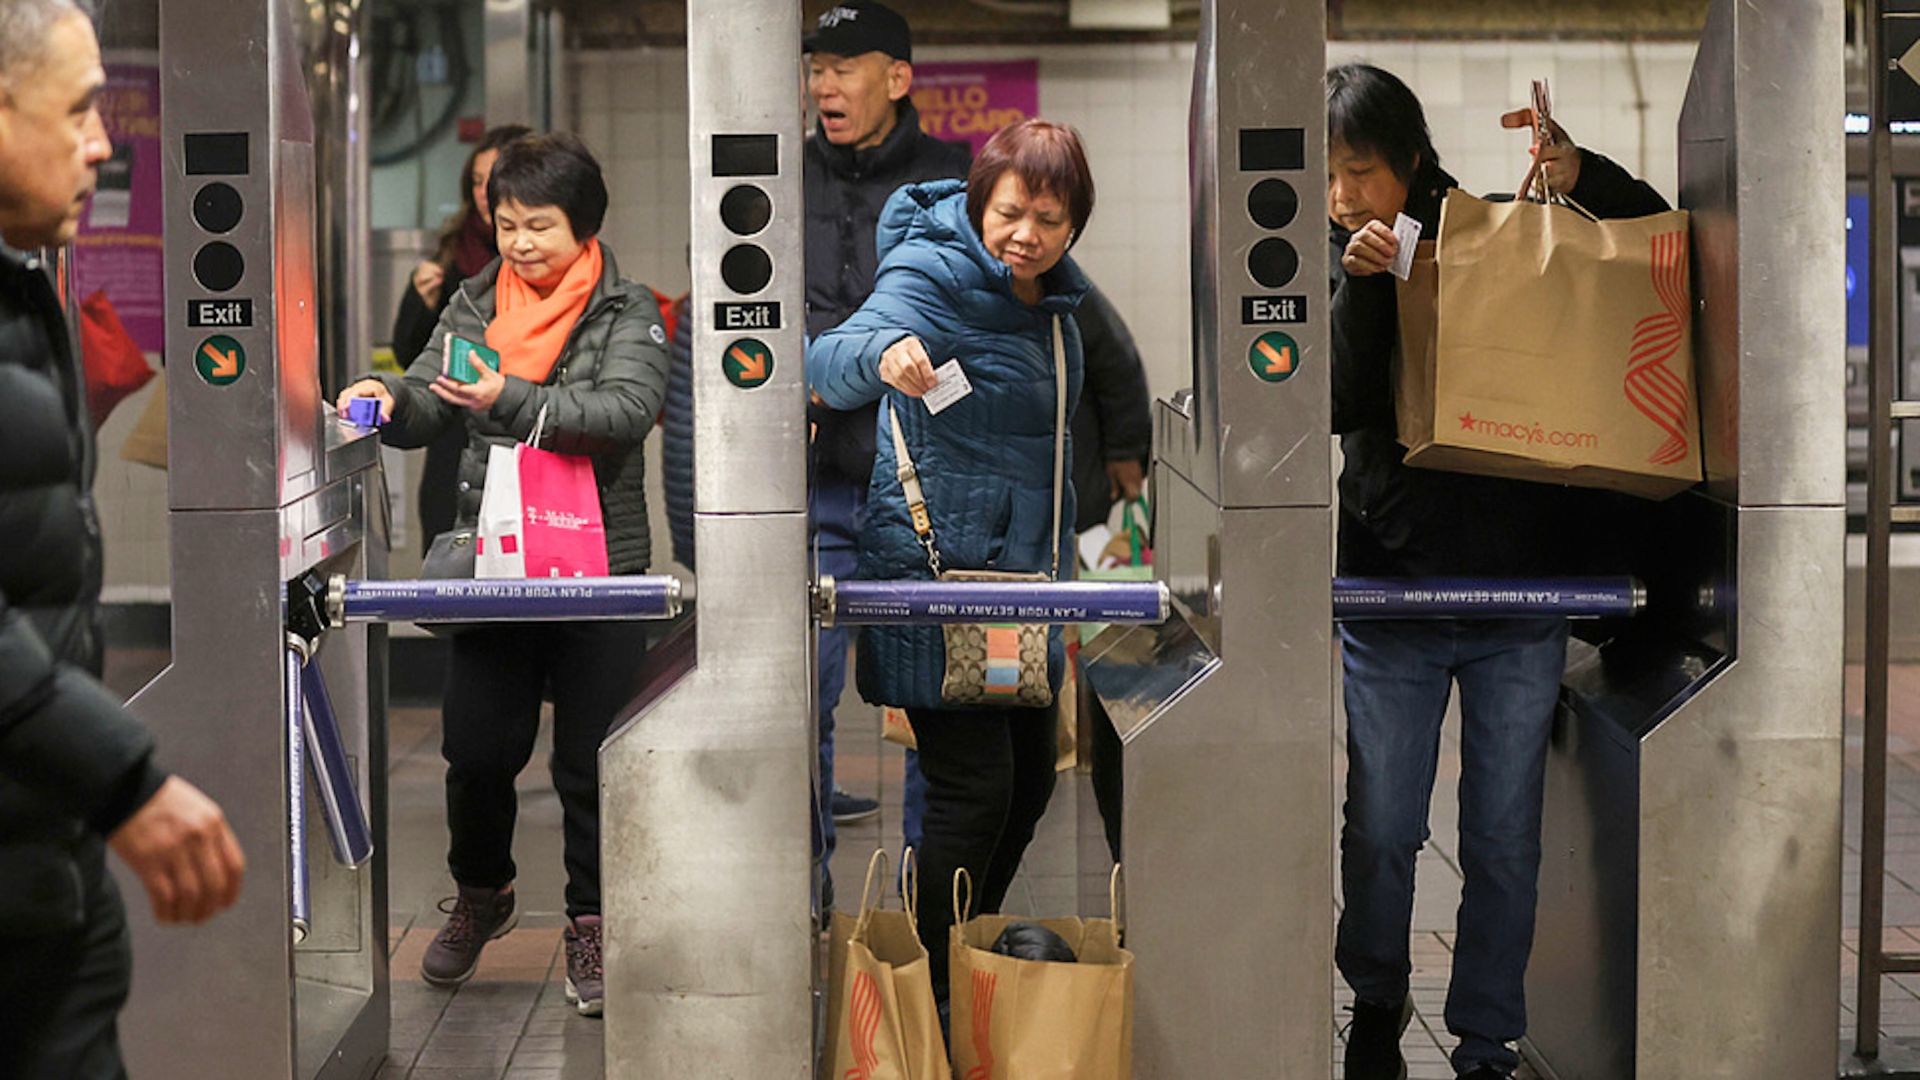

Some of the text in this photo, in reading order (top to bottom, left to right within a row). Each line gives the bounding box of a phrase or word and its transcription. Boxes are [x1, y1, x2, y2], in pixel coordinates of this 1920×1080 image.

[199, 302, 242, 324] Exit
[726, 306, 770, 327] Exit
[1252, 299, 1296, 321] Exit
[435, 585, 592, 598] PLAN YOUR GETAWAY NOW
[1402, 590, 1560, 603] PLAN YOUR GETAWAY NOW
[928, 603, 1087, 618] PLAN YOUR GETAWAY NOW
